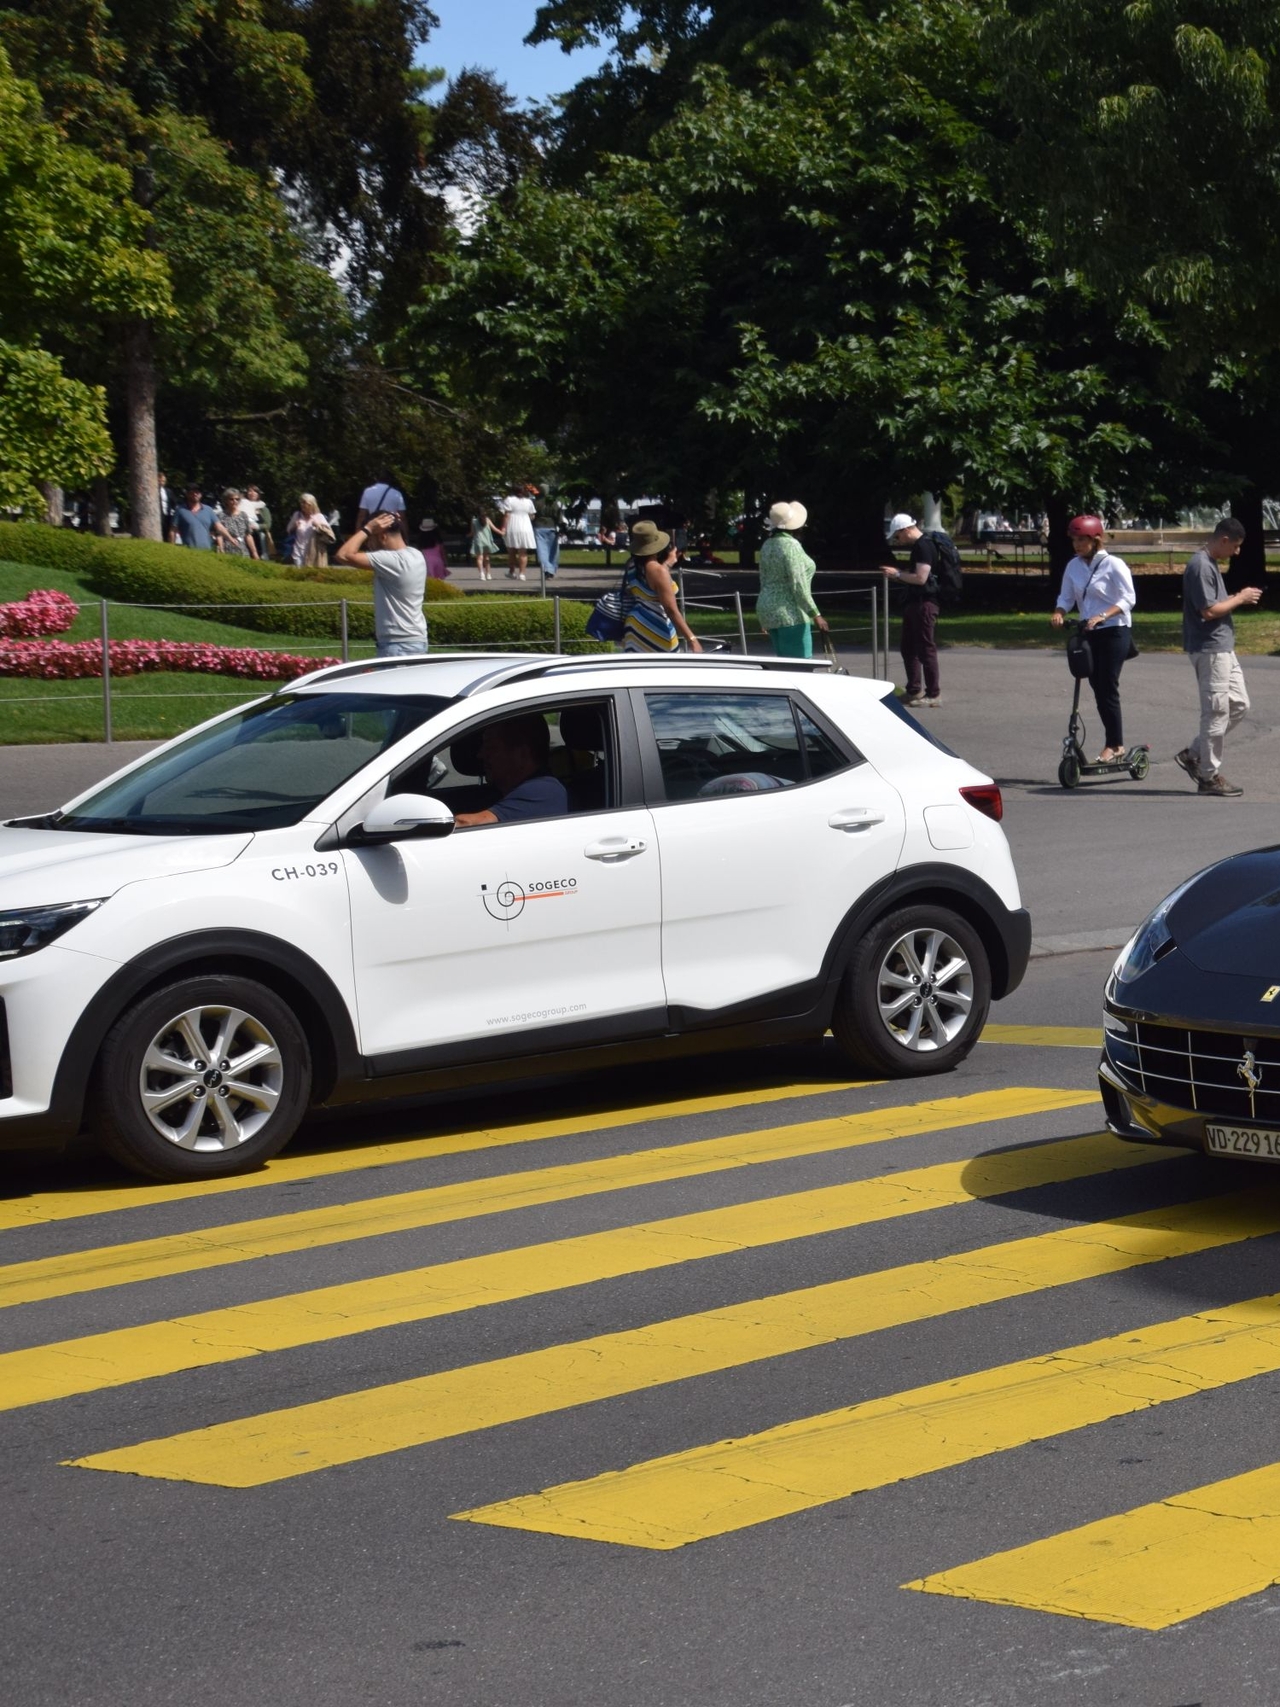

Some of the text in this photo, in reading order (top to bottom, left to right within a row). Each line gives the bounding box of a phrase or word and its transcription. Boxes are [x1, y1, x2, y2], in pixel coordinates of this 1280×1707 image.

[271, 862, 338, 881] CH-039
[528, 877, 577, 892] SOGECO
[485, 1003, 587, 1025] www.sogecogroup.com
